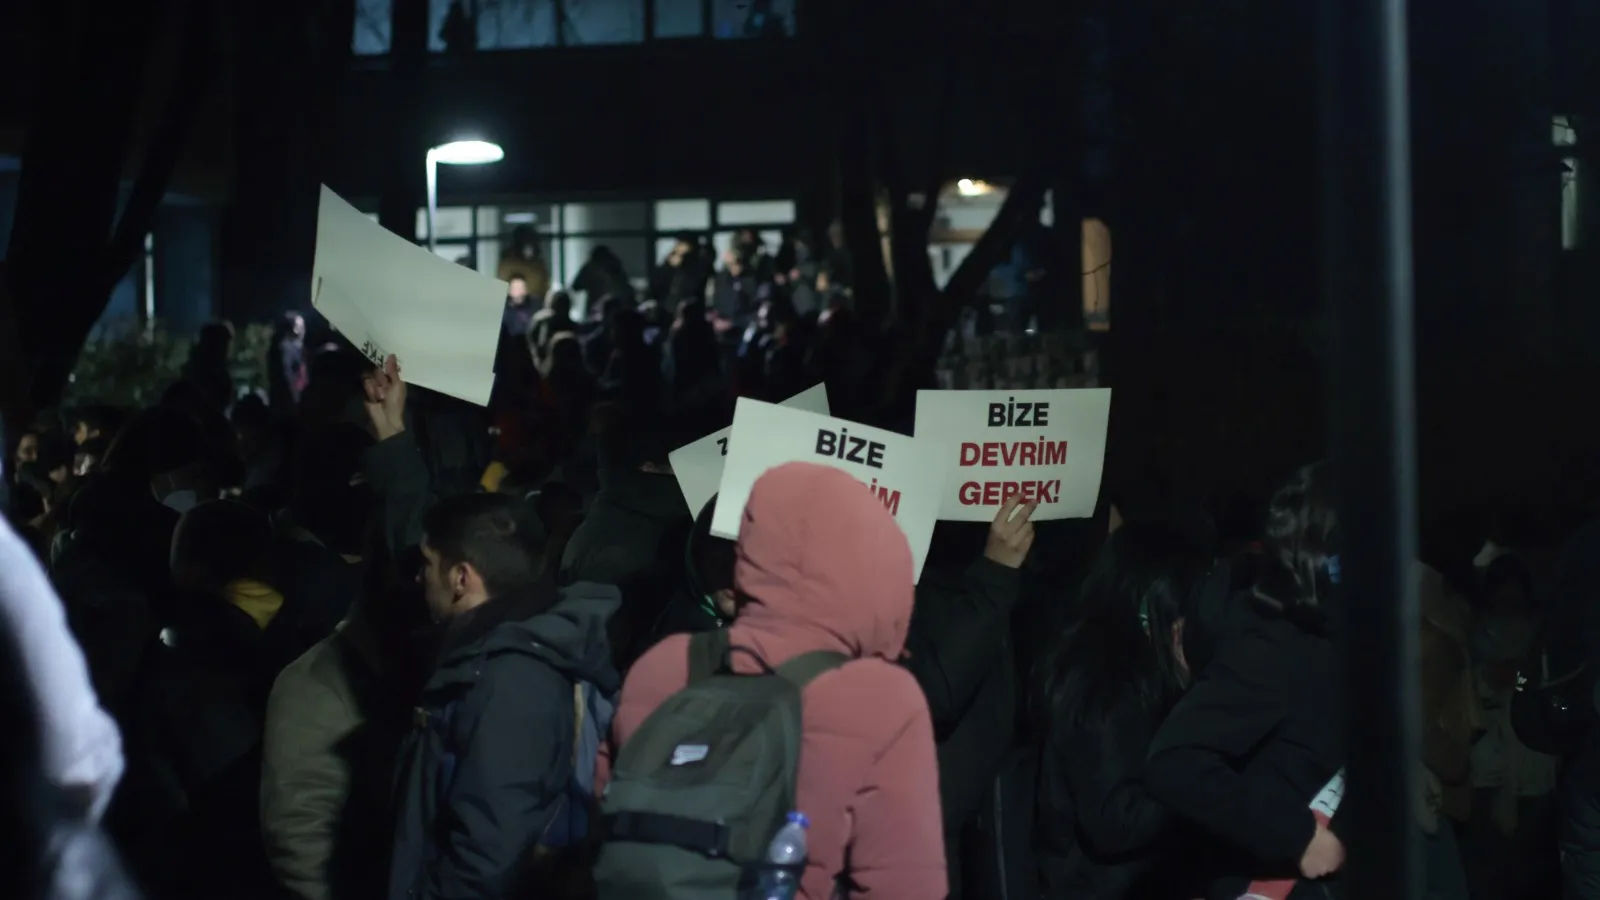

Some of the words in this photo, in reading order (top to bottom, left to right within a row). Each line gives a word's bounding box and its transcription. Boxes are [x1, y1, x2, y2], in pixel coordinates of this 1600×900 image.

[988, 396, 1050, 427] BİZE
[815, 427, 886, 470] BİZE
[959, 435, 1068, 467] DEVRİM
